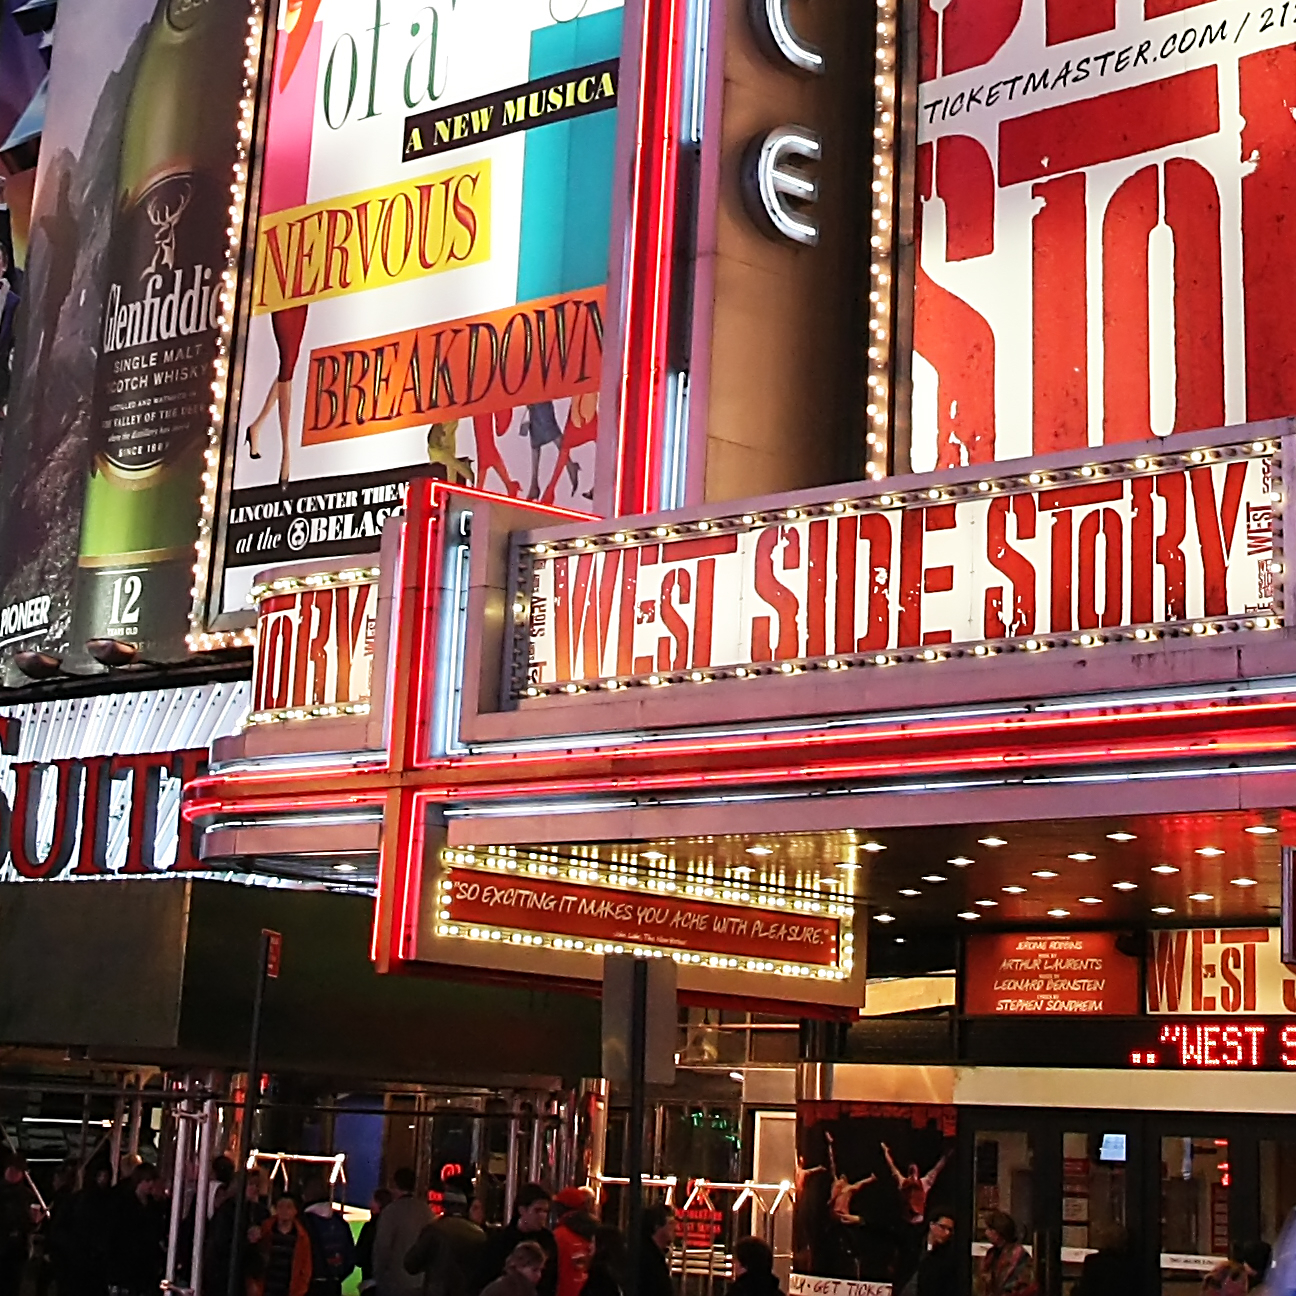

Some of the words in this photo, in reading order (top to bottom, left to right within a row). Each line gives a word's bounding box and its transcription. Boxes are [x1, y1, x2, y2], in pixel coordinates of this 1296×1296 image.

[406, 128, 423, 154] A
[433, 105, 494, 146] NEW
[257, 173, 481, 307] NERVOUS
[114, 352, 157, 373] SINGLE
[163, 343, 203, 364] MALT
[308, 299, 604, 432] BREAKDOWN
[230, 498, 294, 525] LINCOLN
[296, 490, 360, 515] CENTER
[235, 524, 253, 553] at
[256, 523, 282, 549] the
[553, 531, 739, 682] WEST
[749, 504, 958, 663] SIDE
[983, 459, 1250, 641] STORY
[0, 595, 51, 638] PIONEER
[109, 576, 143, 625] 12
[481, 886, 557, 912] EXCITING
[559, 895, 579, 913] IT
[578, 898, 633, 921] MAKES
[636, 906, 670, 926] YOU
[669, 910, 710, 932] ACHE
[712, 916, 748, 936] WITH
[1147, 927, 1270, 1014] WEST
